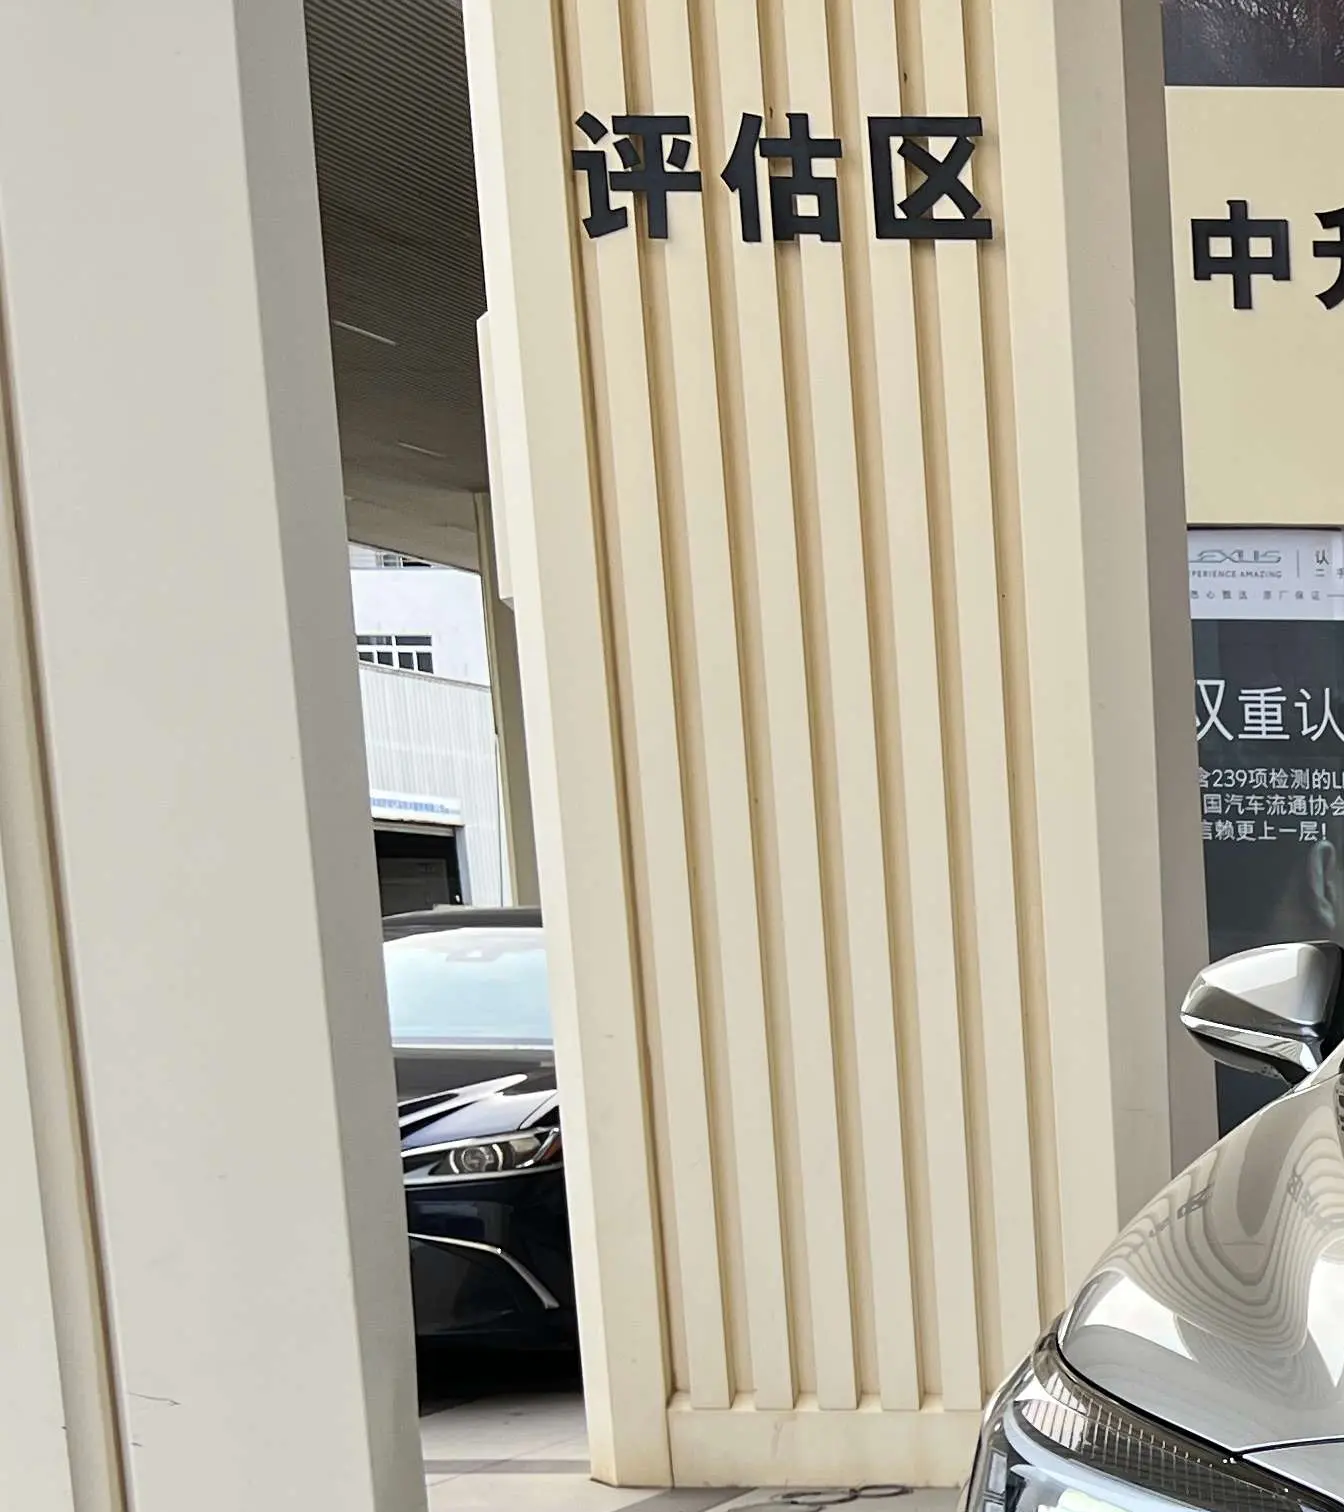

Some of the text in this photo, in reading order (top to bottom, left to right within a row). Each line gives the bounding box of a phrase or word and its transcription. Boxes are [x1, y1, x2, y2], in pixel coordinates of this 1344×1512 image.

[571, 111, 993, 242] 评估区
[1189, 549, 1282, 564] EXUS
[1239, 570, 1283, 579] AMAZING
